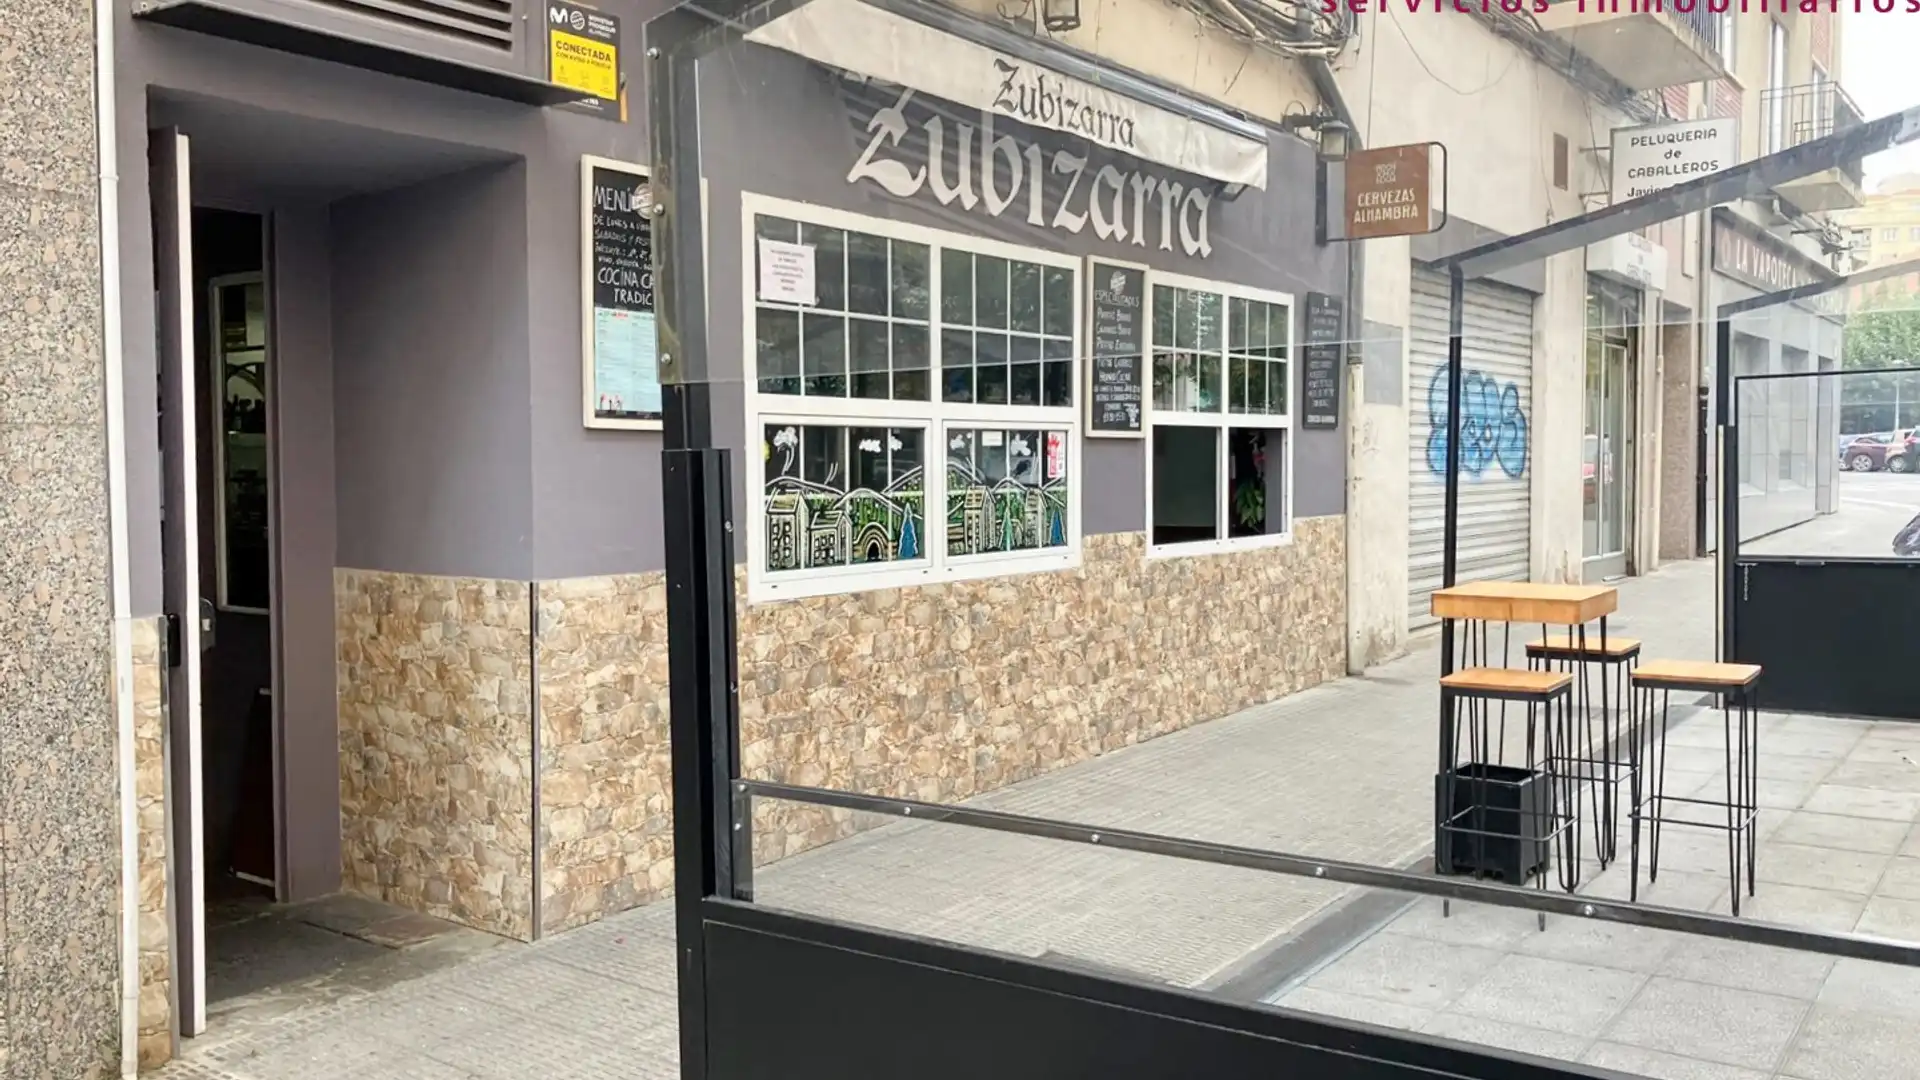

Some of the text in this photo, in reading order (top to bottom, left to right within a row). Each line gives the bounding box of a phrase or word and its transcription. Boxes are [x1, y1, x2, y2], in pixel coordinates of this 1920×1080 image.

[556, 40, 611, 62] CONECTADA
[992, 57, 1135, 149] Zubizarra
[1631, 128, 1717, 148] PELUQUERIA
[1664, 149, 1681, 160] de
[846, 88, 1212, 259] Zubizarra
[1628, 160, 1719, 179] CABALLEROS
[1358, 188, 1415, 207] CERVEZAS
[1354, 203, 1418, 224] ALHAMBRA
[1736, 239, 1748, 274] LA
